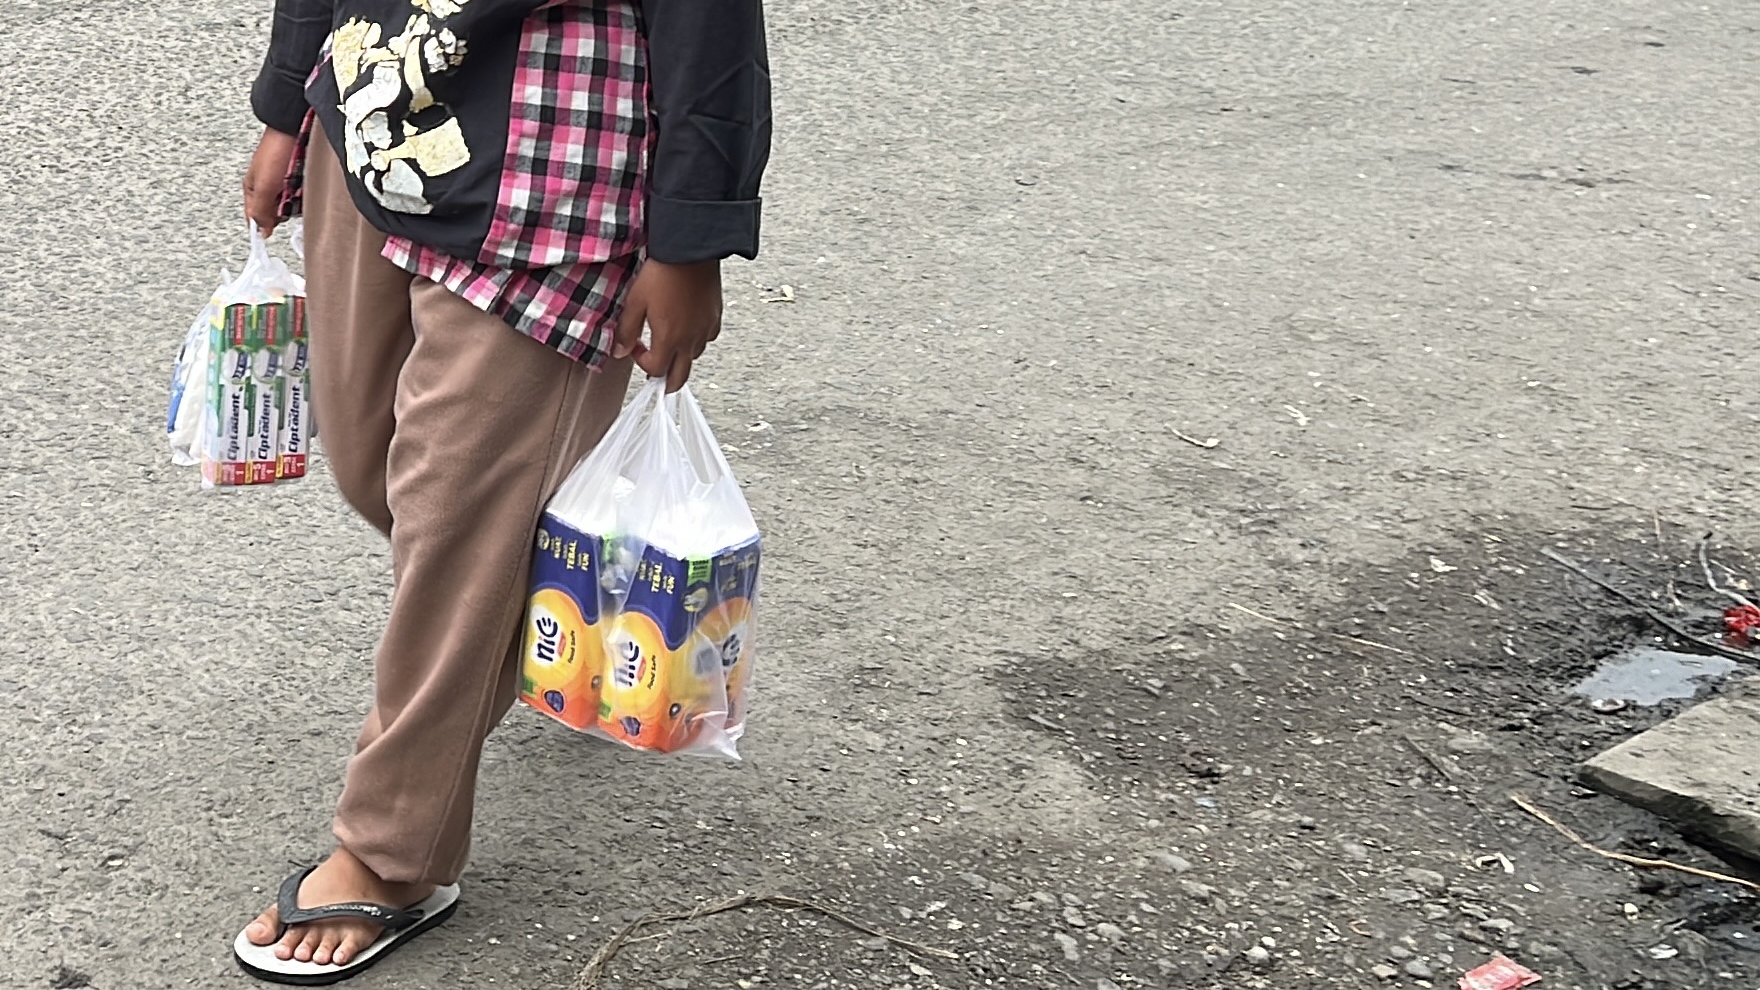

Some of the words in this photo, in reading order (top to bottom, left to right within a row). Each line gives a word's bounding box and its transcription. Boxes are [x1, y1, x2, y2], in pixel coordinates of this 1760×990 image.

[258, 392, 272, 460] Ciptadent
[288, 386, 301, 453] Ciptadent
[580, 552, 590, 571] FUN
